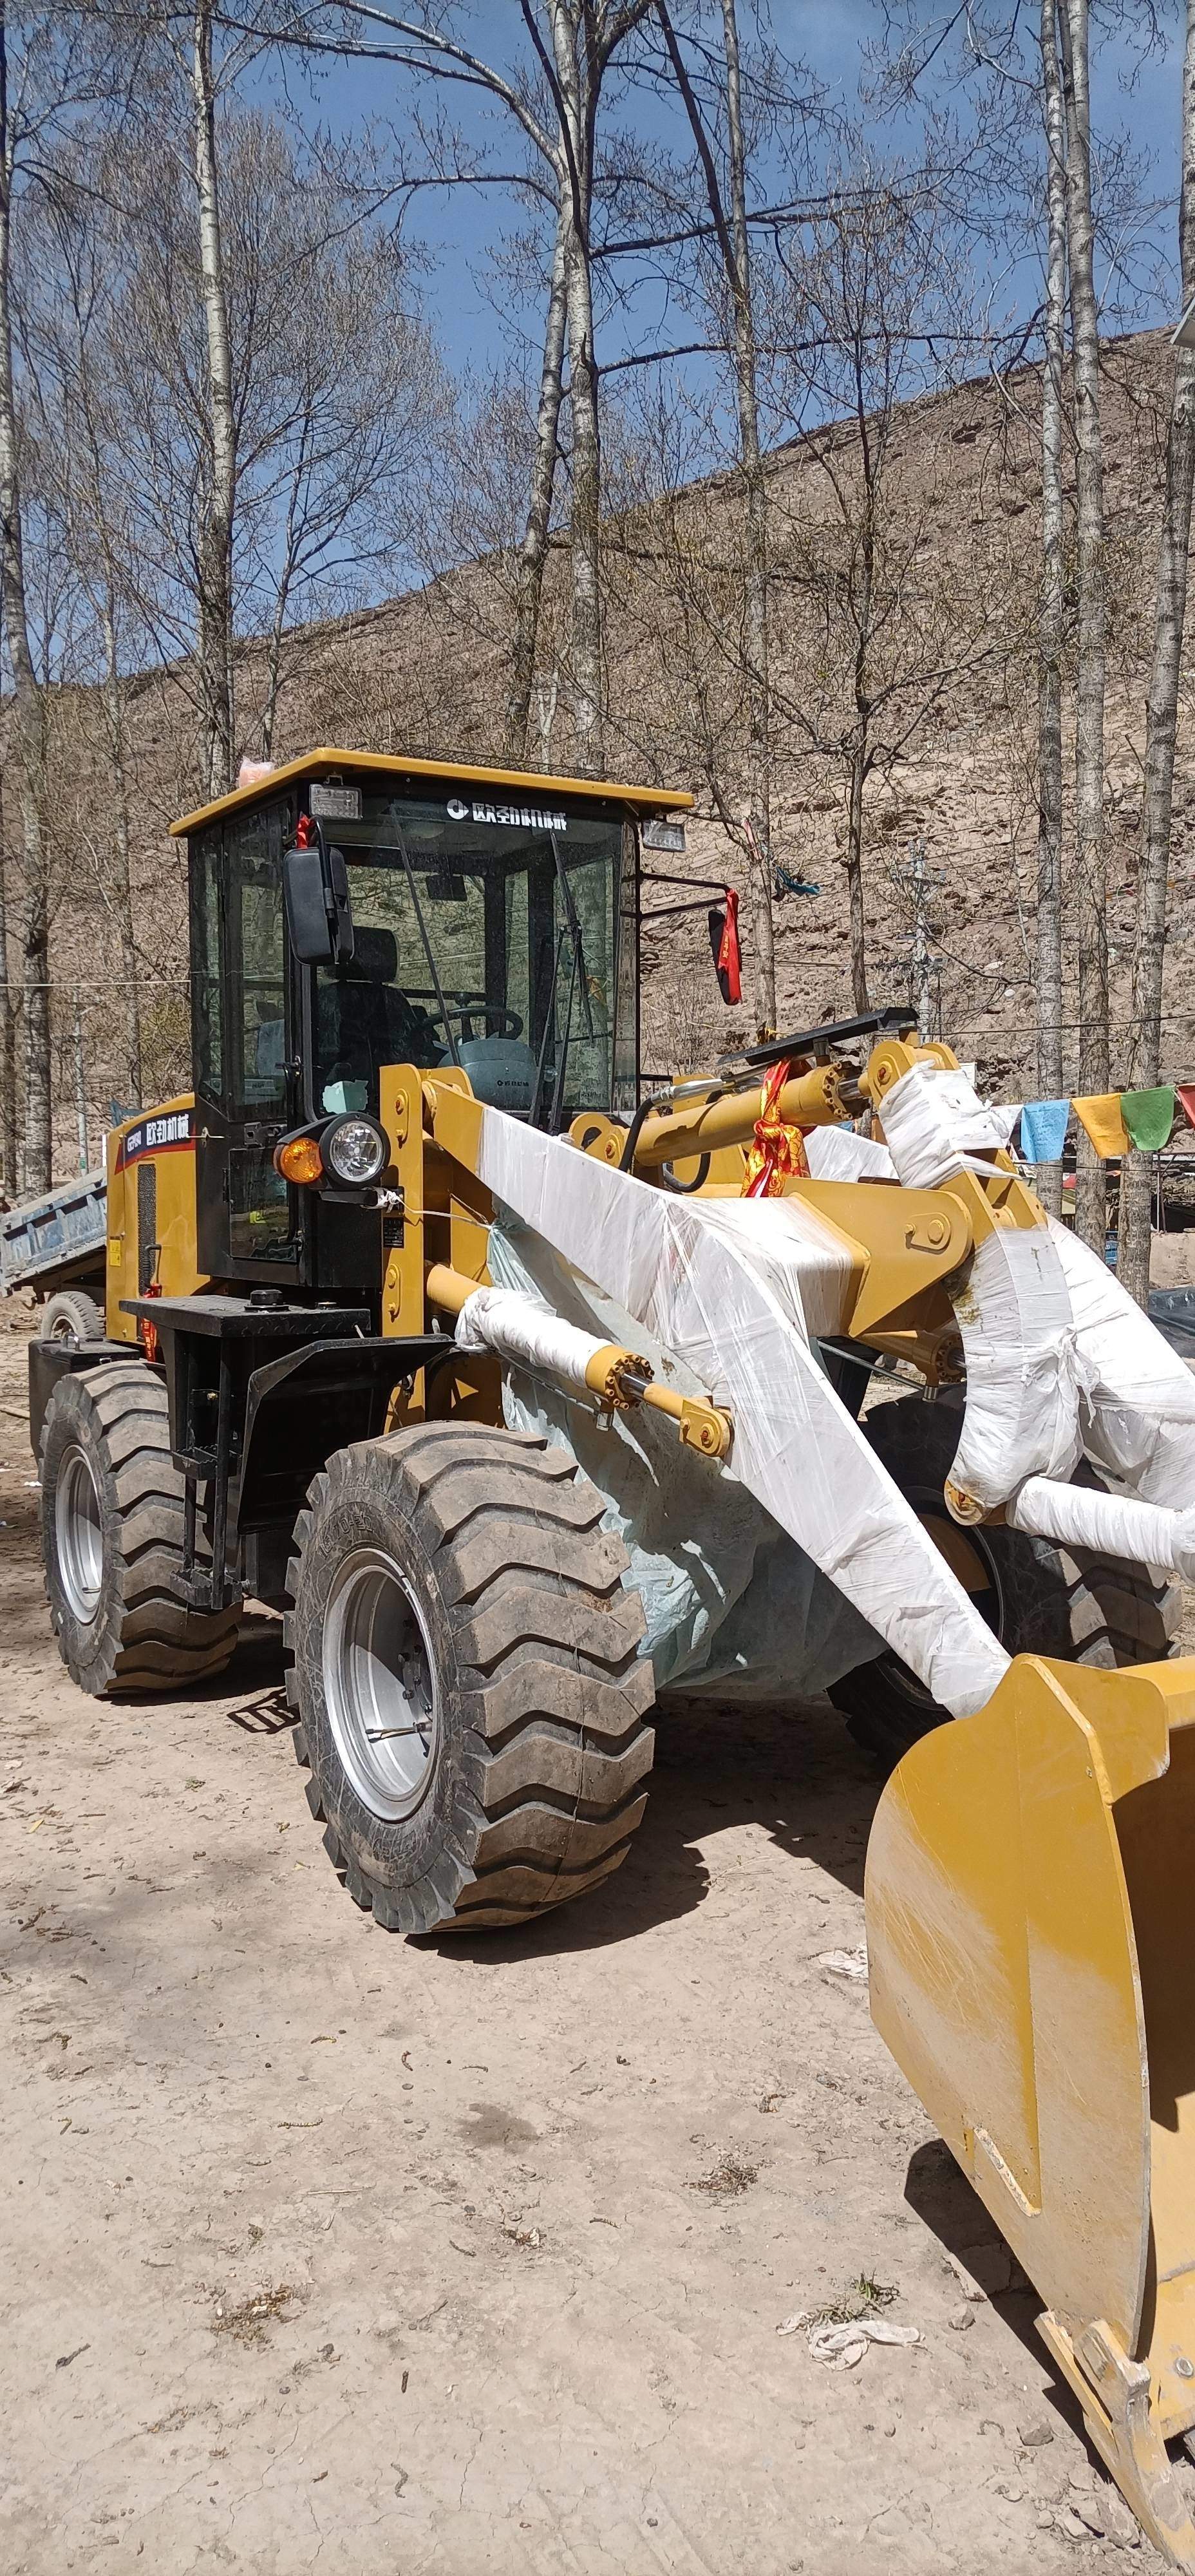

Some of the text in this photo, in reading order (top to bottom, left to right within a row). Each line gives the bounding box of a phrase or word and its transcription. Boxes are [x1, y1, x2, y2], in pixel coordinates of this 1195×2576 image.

[472, 802, 567, 831] 欧劲机械
[146, 1113, 189, 1146] 欧劲机械
